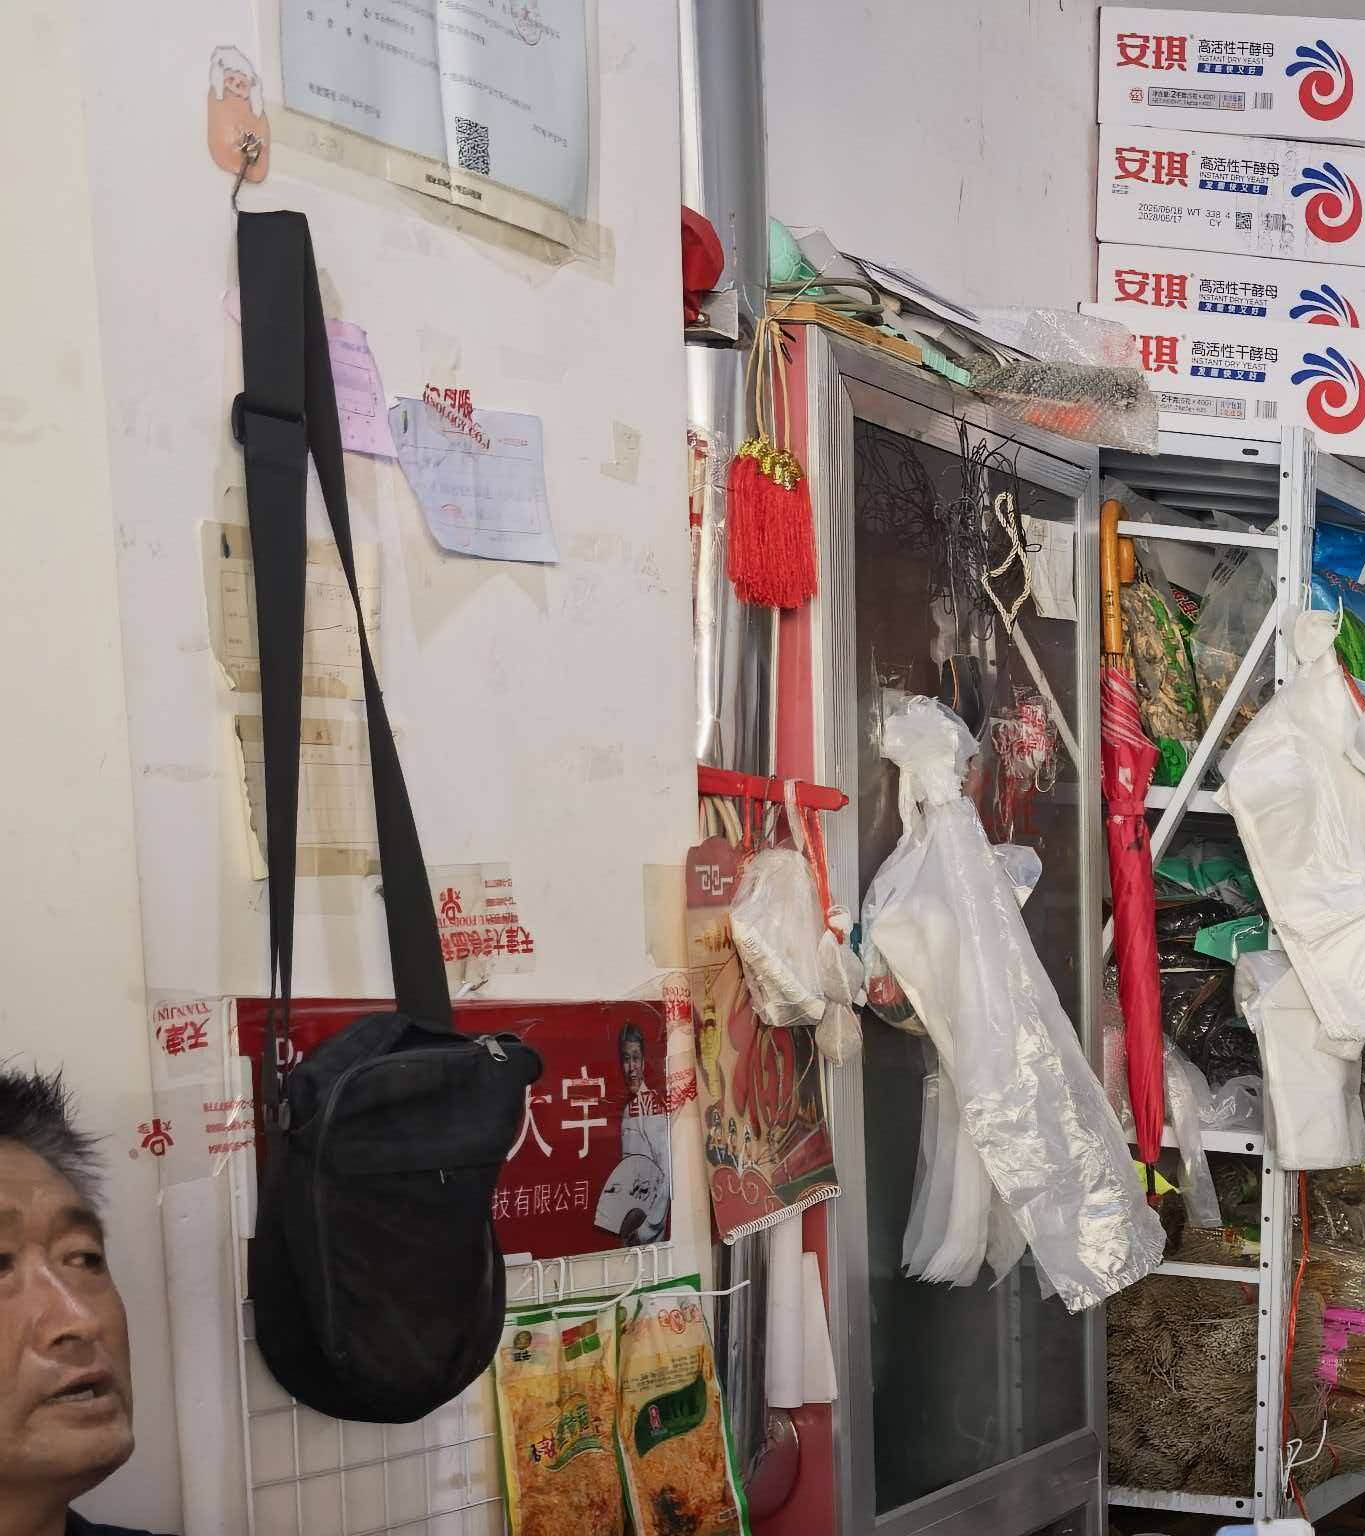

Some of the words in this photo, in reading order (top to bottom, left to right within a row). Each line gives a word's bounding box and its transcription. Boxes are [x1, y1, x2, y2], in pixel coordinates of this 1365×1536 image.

[1117, 33, 1187, 71] 安琪
[1198, 39, 1274, 57] 高活性干酵母
[1115, 147, 1188, 187] 安琪
[1200, 157, 1279, 177] 高活性干酵母
[1115, 269, 1188, 309] 安琪
[1200, 279, 1278, 299] 高活性干酵母
[1132, 334, 1179, 375] 琪
[1191, 341, 1278, 363] 高活性干酵母
[1243, 361, 1267, 371] YEAST
[156, 1017, 210, 1056] 天津
[506, 1065, 608, 1161] 大宇
